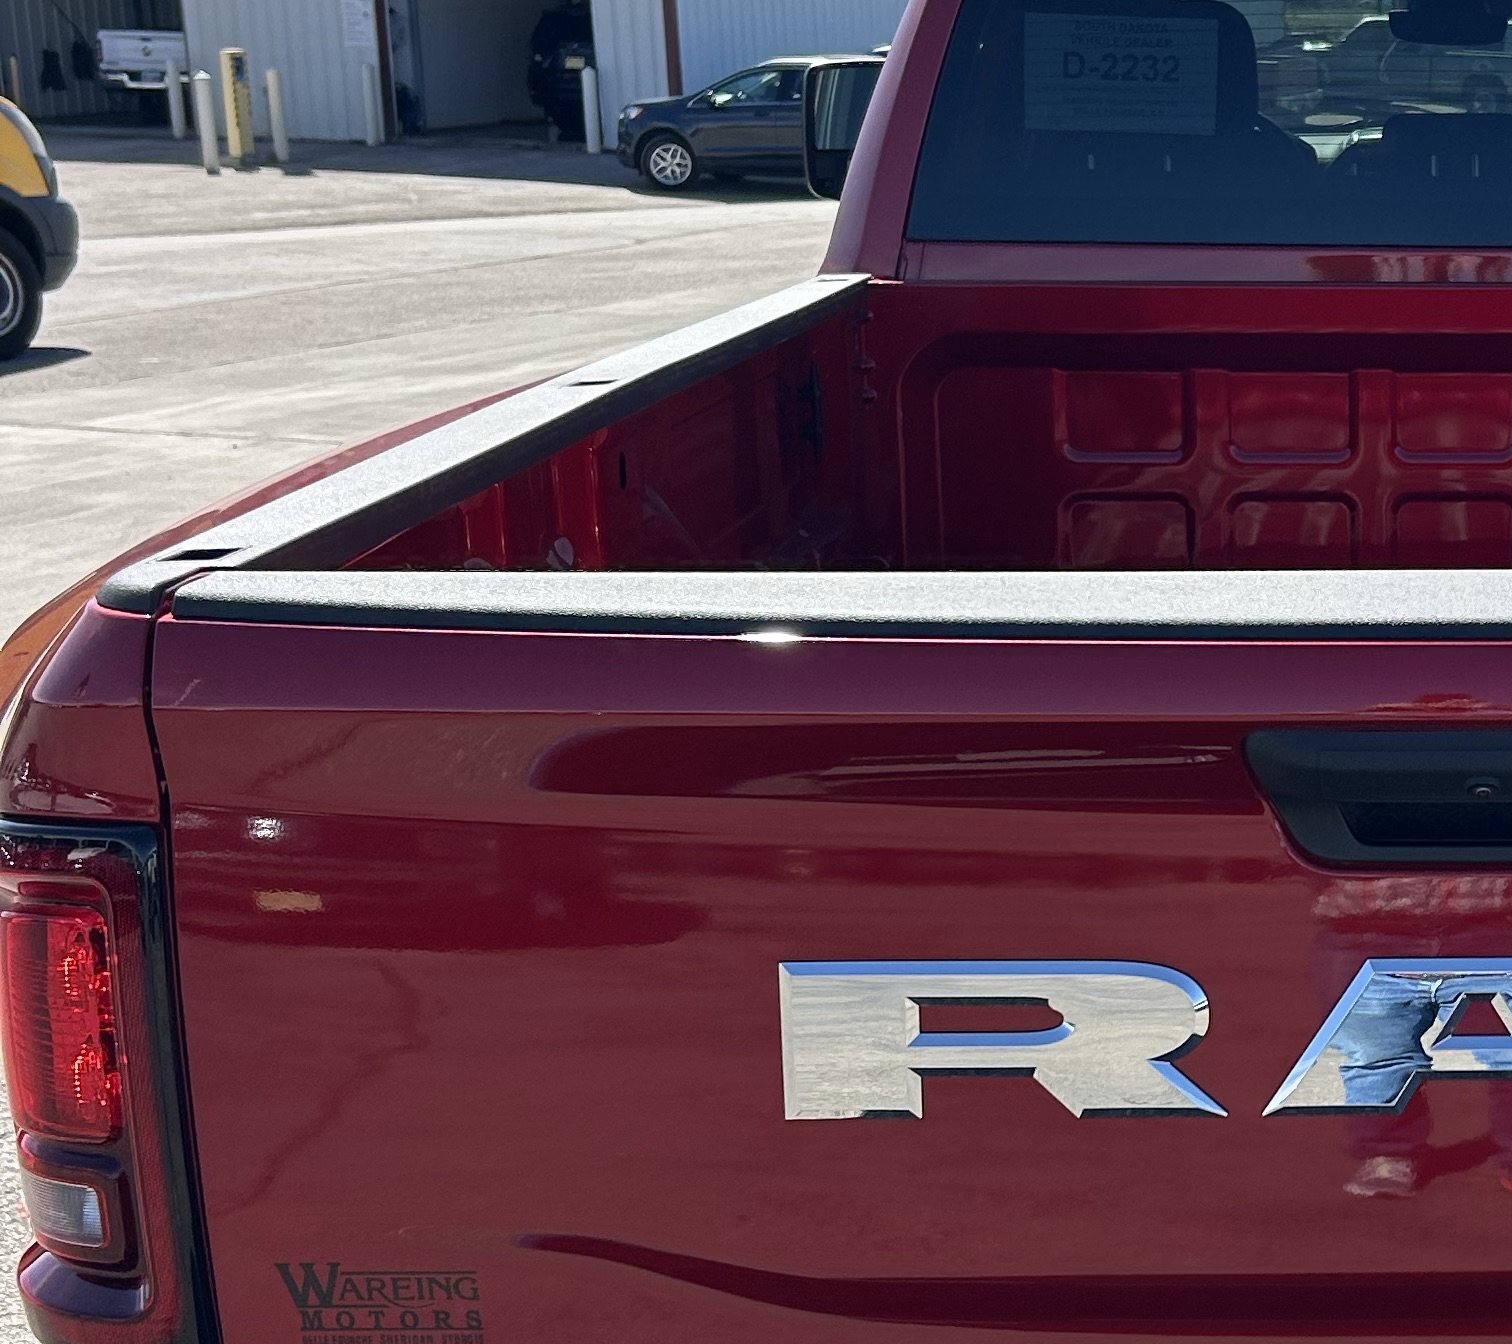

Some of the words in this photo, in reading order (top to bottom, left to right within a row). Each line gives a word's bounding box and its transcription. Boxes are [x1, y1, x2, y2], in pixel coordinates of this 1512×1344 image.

[1119, 22, 1169, 34] DAKOTA
[1063, 51, 1180, 83] D-2232
[274, 1262, 480, 1308] WAREING
[301, 1310, 483, 1329] MOTORS
[379, 1333, 433, 1344] SHERIDAN
[441, 1333, 485, 1344] STURGIS
